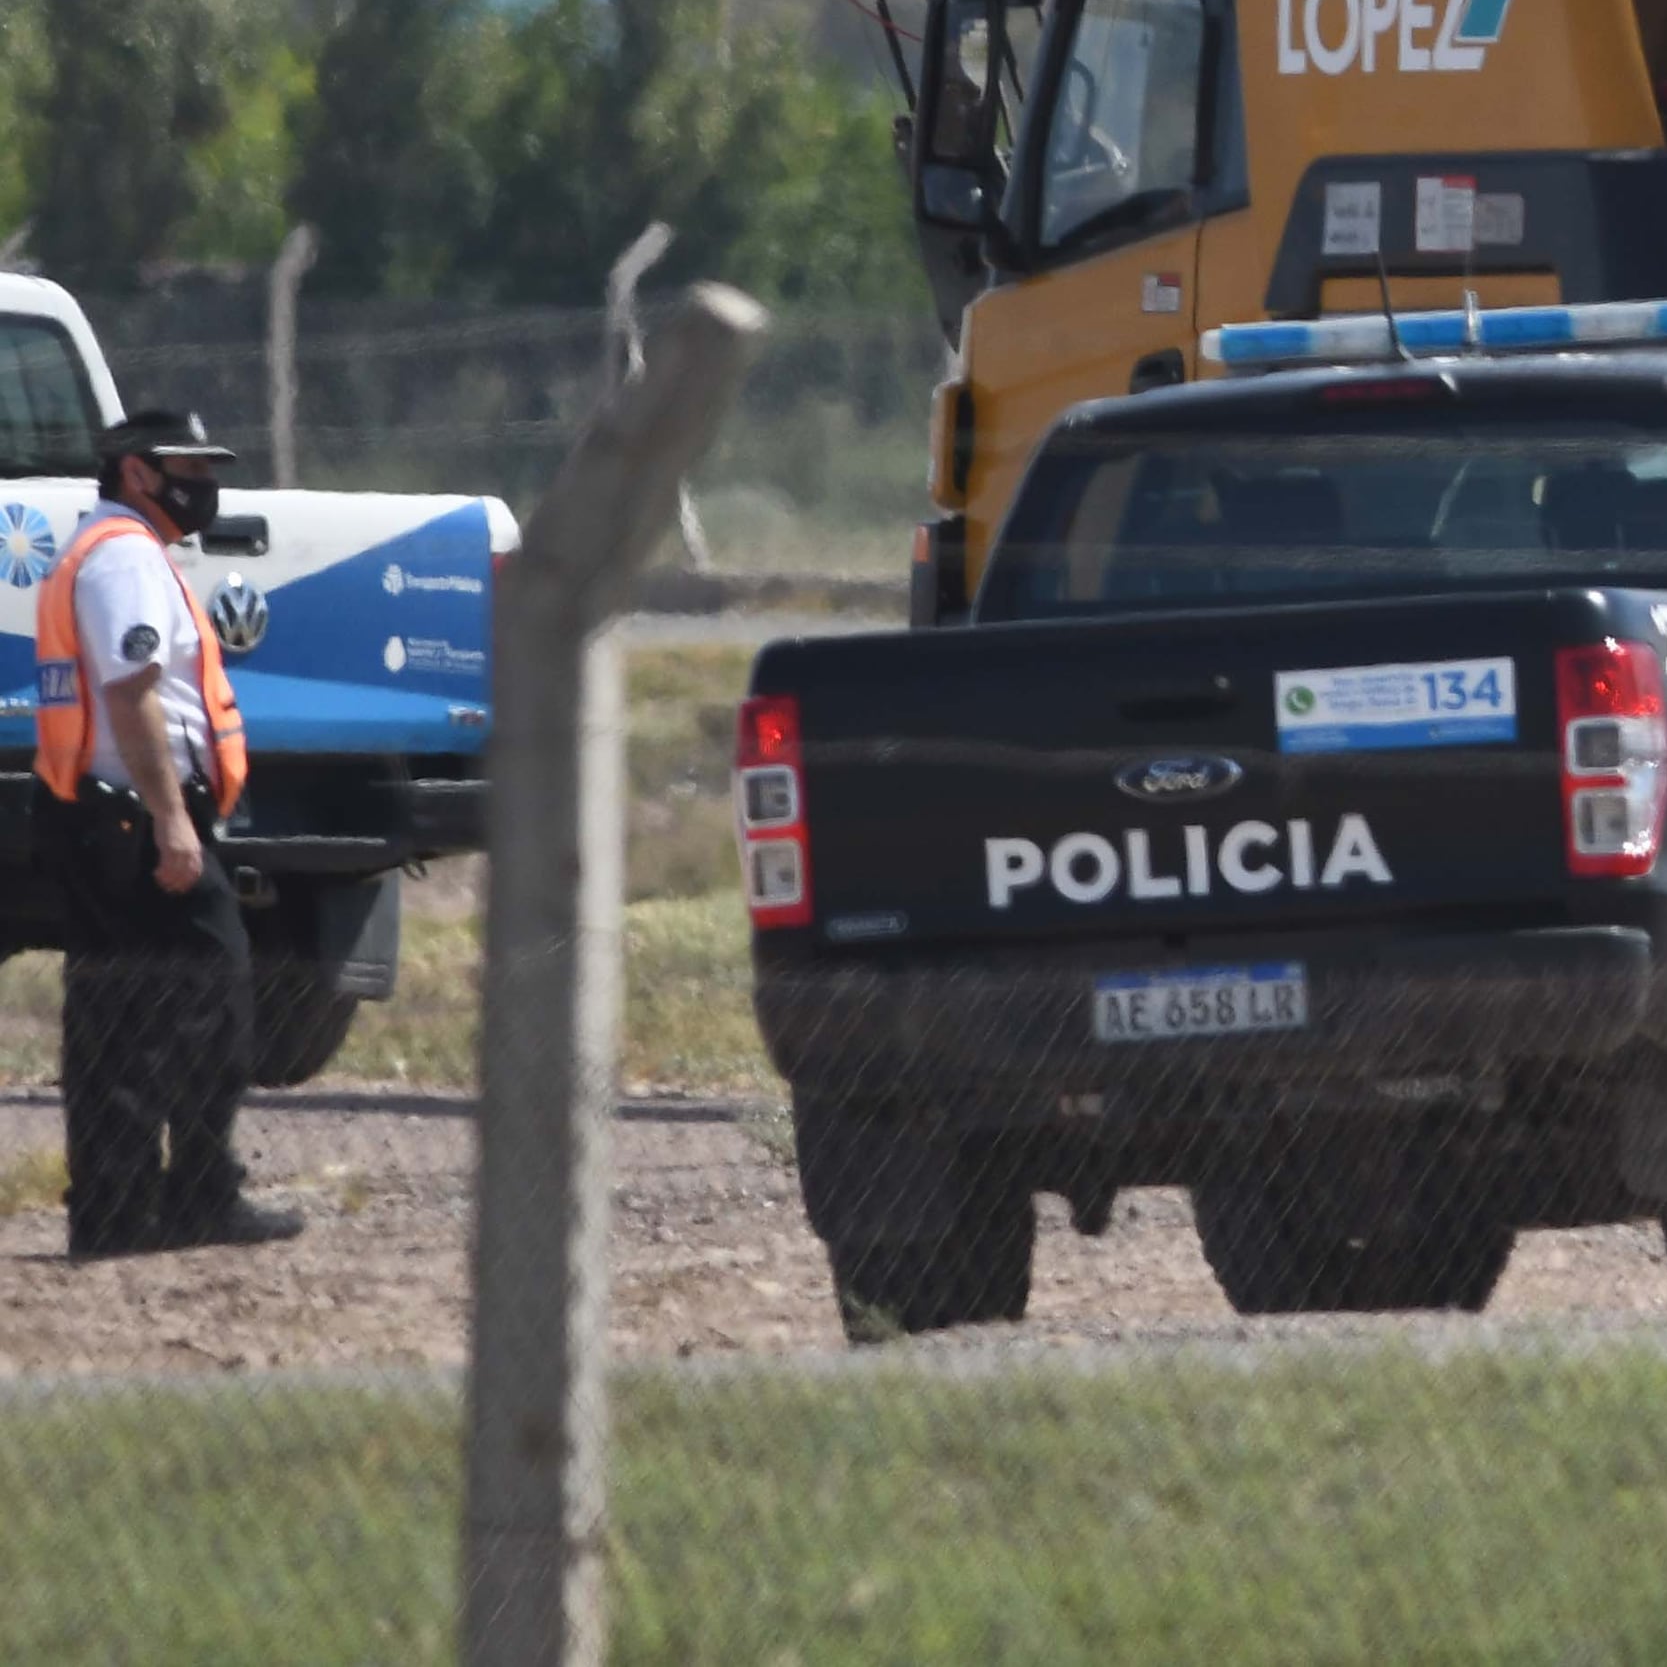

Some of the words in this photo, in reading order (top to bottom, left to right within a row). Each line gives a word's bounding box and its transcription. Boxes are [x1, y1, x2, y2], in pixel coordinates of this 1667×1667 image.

[1421, 668, 1503, 711] 134
[1143, 759, 1212, 793] Ford
[984, 812, 1395, 909] POLICIA
[1105, 992, 1151, 1034] AE
[1163, 987, 1238, 1030] 658
